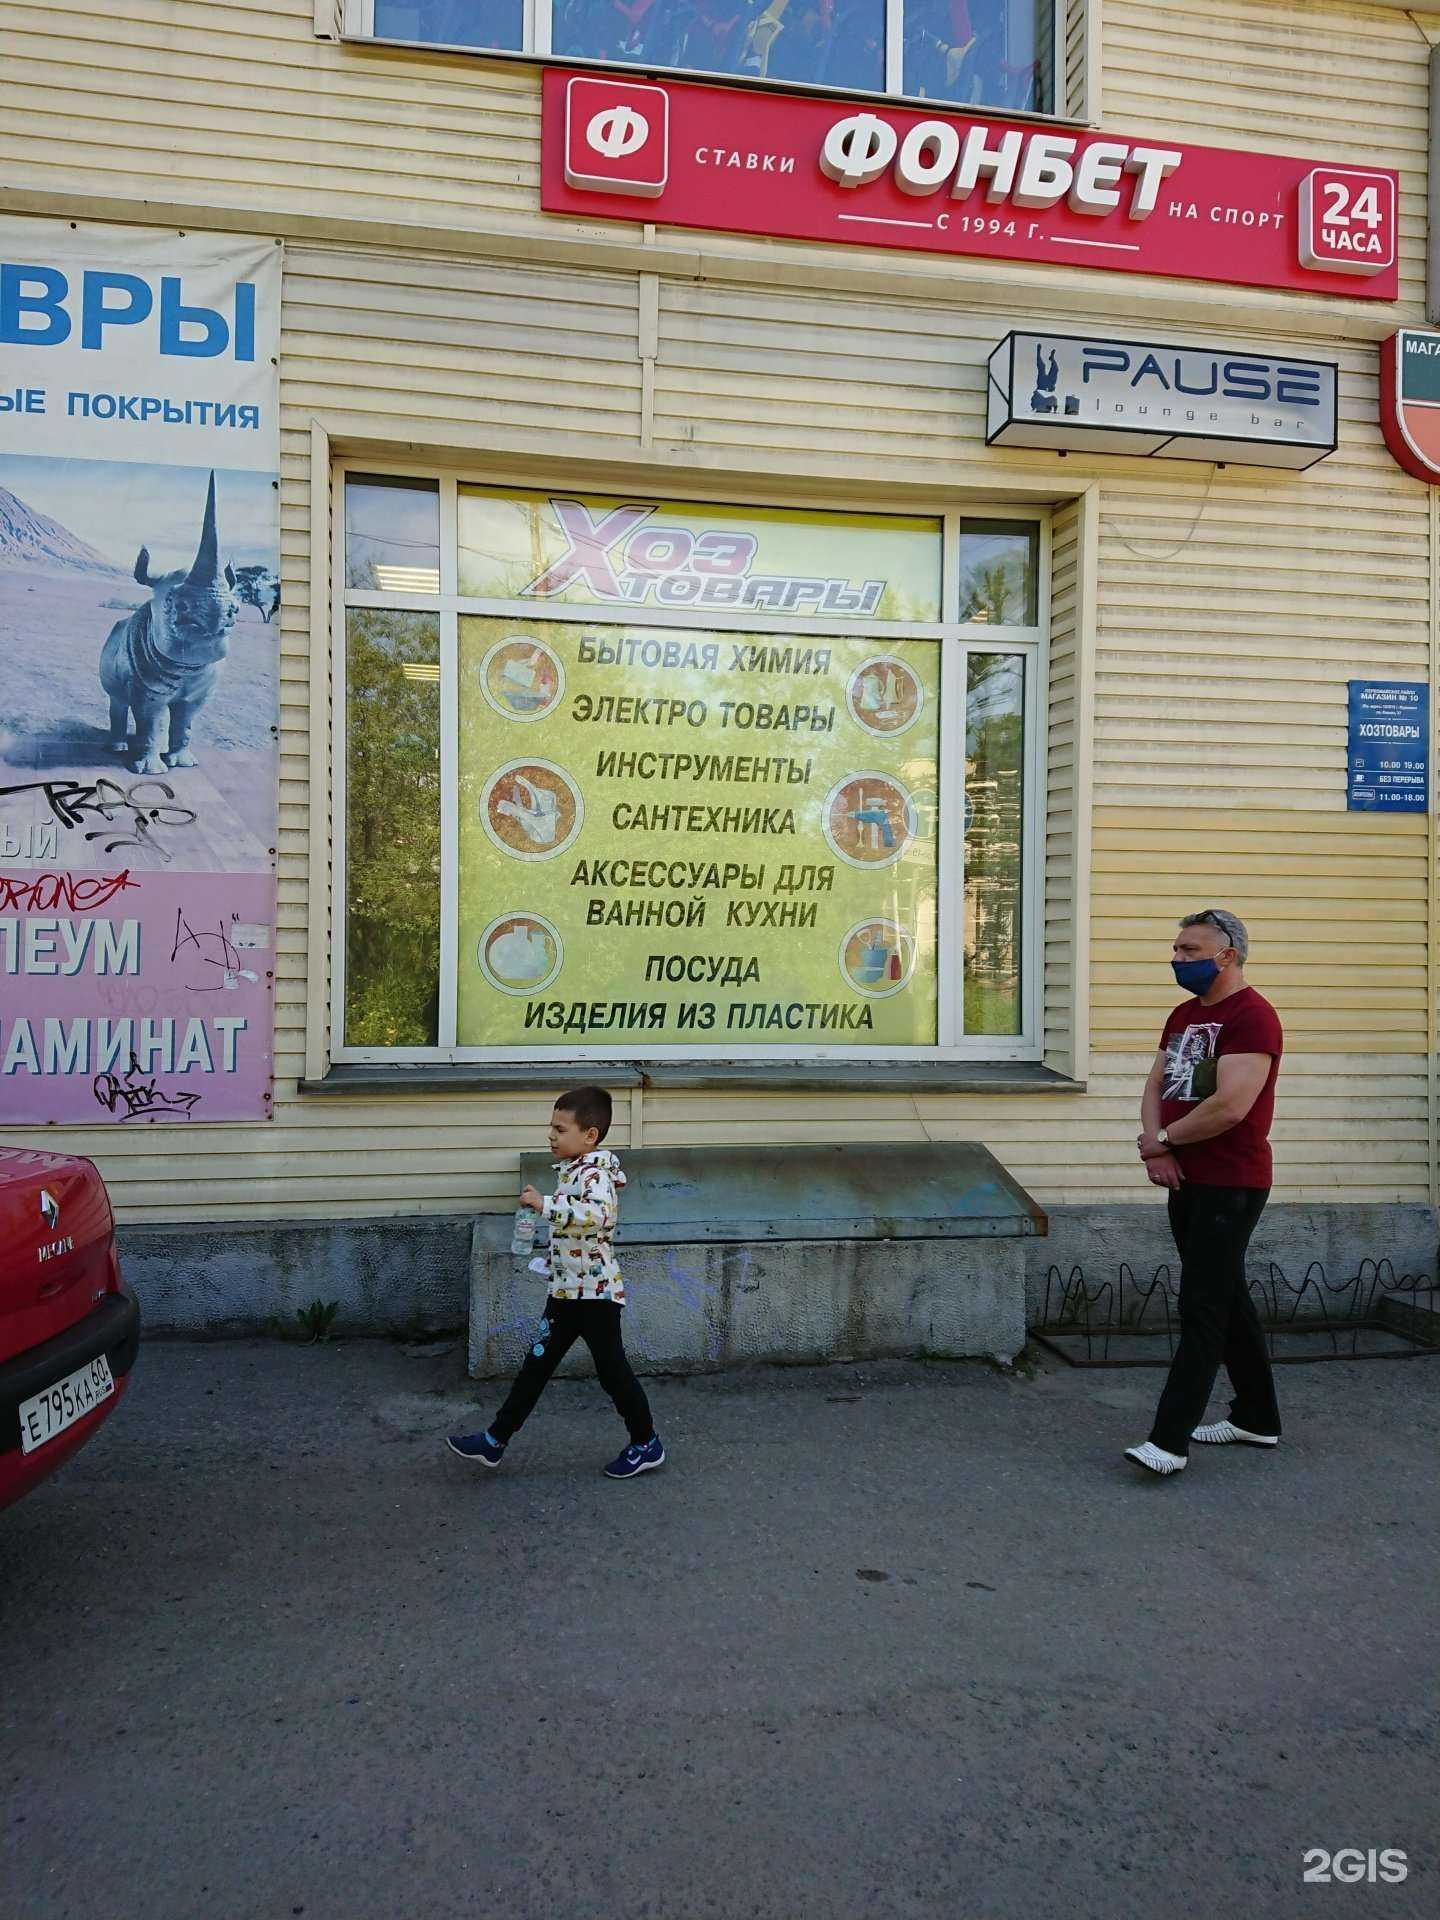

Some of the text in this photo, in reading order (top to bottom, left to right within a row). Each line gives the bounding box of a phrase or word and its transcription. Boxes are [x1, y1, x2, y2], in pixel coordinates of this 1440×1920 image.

[586, 106, 649, 158] Ф
[695, 147, 795, 174] СТАВКИ
[819, 113, 1182, 220] ФОНБЕТ
[1168, 201, 1285, 229] НА СПОРТ
[1322, 182, 1383, 229] 24
[937, 214, 1044, 240] С 1994 Г.
[1321, 228, 1383, 254] ЧАСА
[0, 263, 255, 362] ВРЫ
[1082, 347, 1321, 406] PAUSE
[67, 391, 259, 430] ПОКРЫТИЯ
[1096, 397, 1305, 430] lounge bar
[577, 636, 832, 675] БЫТОВАЯ ХИМИЯ
[572, 694, 836, 732] ЭЛЕКТРО ТОВАРЫ
[1360, 693, 1397, 701] МАГАЗИН
[1359, 723, 1420, 738] ХОЗТОВАРЫ
[595, 750, 813, 785] ИНСТРУМЕНТЫ
[1379, 775, 1425, 784] БЕЗ ПЕРЕРЫВА
[1380, 761, 1425, 770] 10.00 19.00
[1379, 793, 1425, 802] 11.00-18.00
[611, 802, 797, 835] САНТЕХНИКА
[570, 859, 836, 895] АКСЕССУАРЫ ДЛЯ
[586, 896, 818, 928] ВАННОЙ КУХНИ
[644, 955, 761, 988] ПОСУДА
[524, 1001, 874, 1034] ИЗДЕЛИЯ ИЗ ПЛАСТИКА
[1, 1017, 247, 1075] АМИНАТ
[91, 1358, 106, 1387] 60
